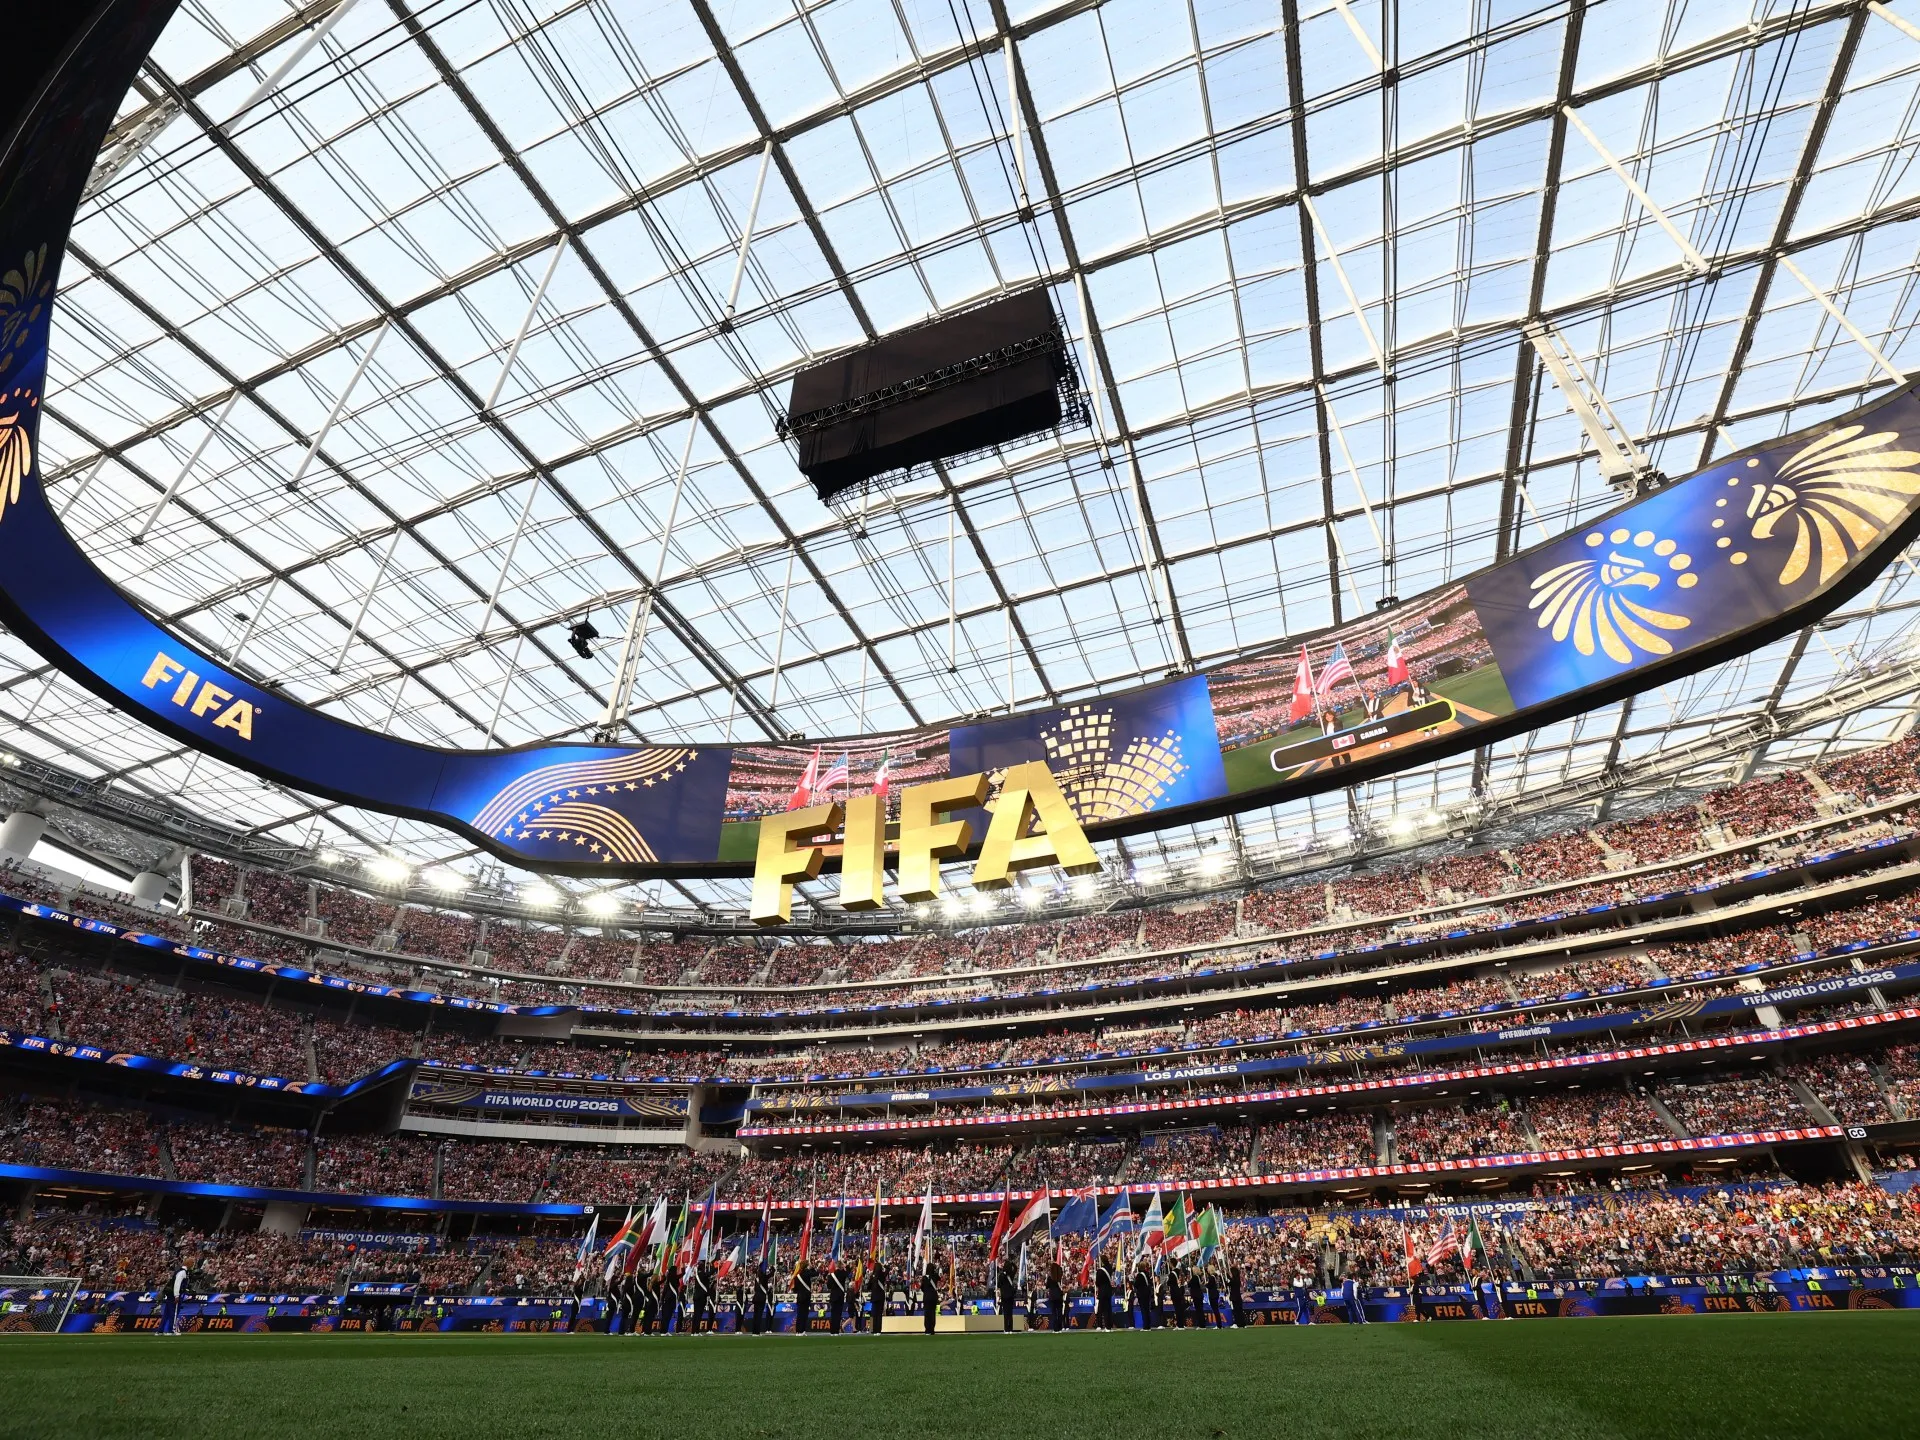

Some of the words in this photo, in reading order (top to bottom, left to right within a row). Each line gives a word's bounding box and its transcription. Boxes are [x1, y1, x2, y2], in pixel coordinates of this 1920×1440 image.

[141, 651, 253, 740] FIFA
[1360, 726, 1388, 740] CANADA
[750, 760, 1102, 927] FIFA
[50, 912, 69, 922] FIFA
[99, 925, 117, 935] FIFA
[197, 952, 214, 960] FIFA
[240, 960, 256, 968] FIFA
[1742, 991, 1771, 1006] FIFA
[1771, 984, 1818, 1001] WORLD
[1818, 980, 1846, 992] CUP
[1846, 970, 1896, 987] 2026
[1499, 1027, 1550, 1040] #FIFAWorldCup
[23, 1038, 45, 1049] FIFA
[81, 1049, 102, 1059] FIFA
[211, 1072, 230, 1080] FIFA
[1144, 1071, 1172, 1081] LOS
[1174, 1065, 1238, 1079] ANGELES
[260, 1078, 278, 1087] FIFA
[485, 1095, 510, 1105] FIFA
[512, 1096, 554, 1108] WORLD
[555, 1099, 578, 1109] CUP
[579, 1101, 618, 1111] 2026
[1850, 1129, 1865, 1137] CC
[1428, 1206, 1470, 1217] ORLD
[1472, 1205, 1492, 1215] CUP
[1890, 1267, 1914, 1276] FIFA
[1704, 1297, 1740, 1310] FIFA
[1796, 1295, 1835, 1308] FIFA
[1435, 1306, 1466, 1317] FIFA
[1515, 1303, 1548, 1314] FIFA
[208, 1318, 234, 1329] FIFA
[340, 1320, 360, 1329] FIFA
[510, 1321, 526, 1329] FIFA
[700, 1321, 718, 1329] FIA
[811, 1321, 831, 1329] FIFA
